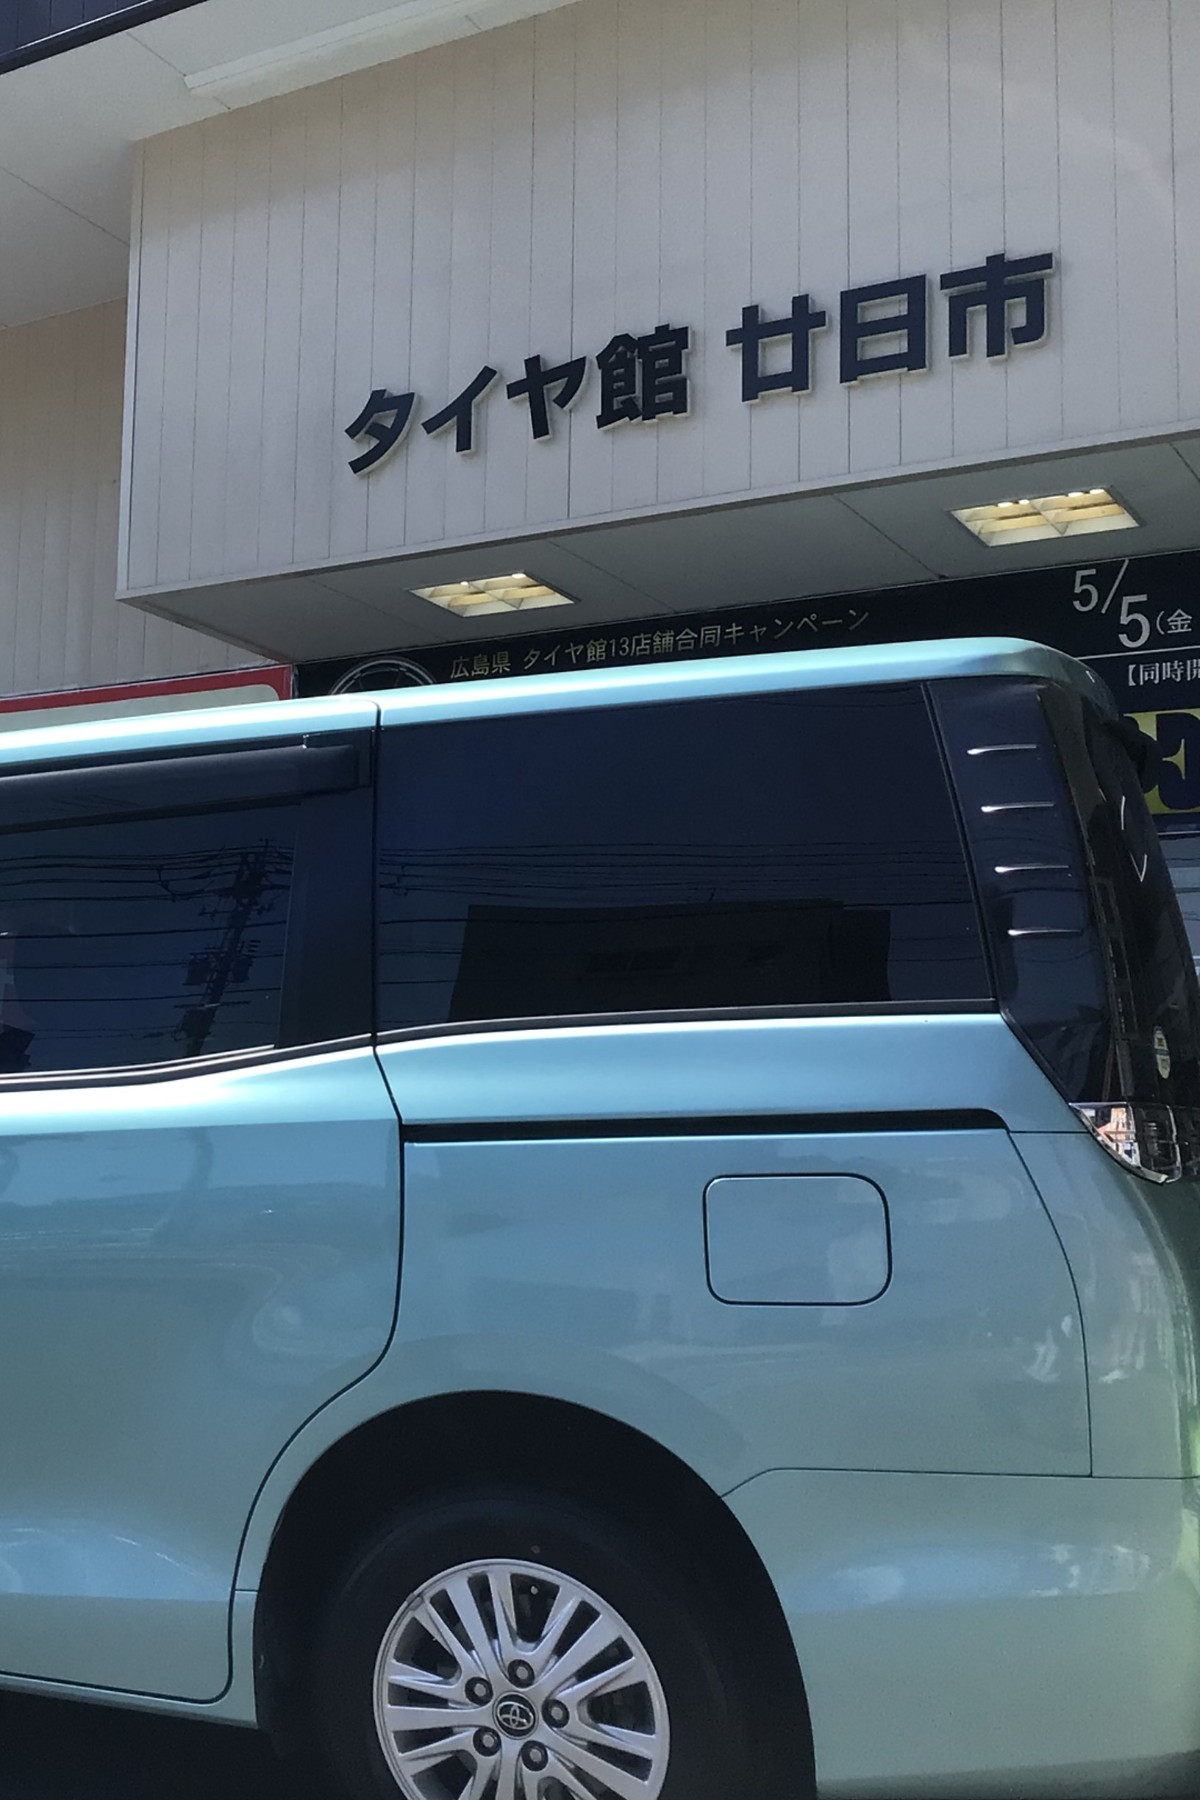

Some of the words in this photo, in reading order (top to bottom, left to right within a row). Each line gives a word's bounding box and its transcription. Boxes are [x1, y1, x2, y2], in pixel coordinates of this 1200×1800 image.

[345, 322, 690, 475] タイヤ館
[725, 252, 1054, 403] 廿日市
[450, 651, 511, 679] 広島県
[523, 609, 869, 670] タイヤ館13店舗合同キャンペーン
